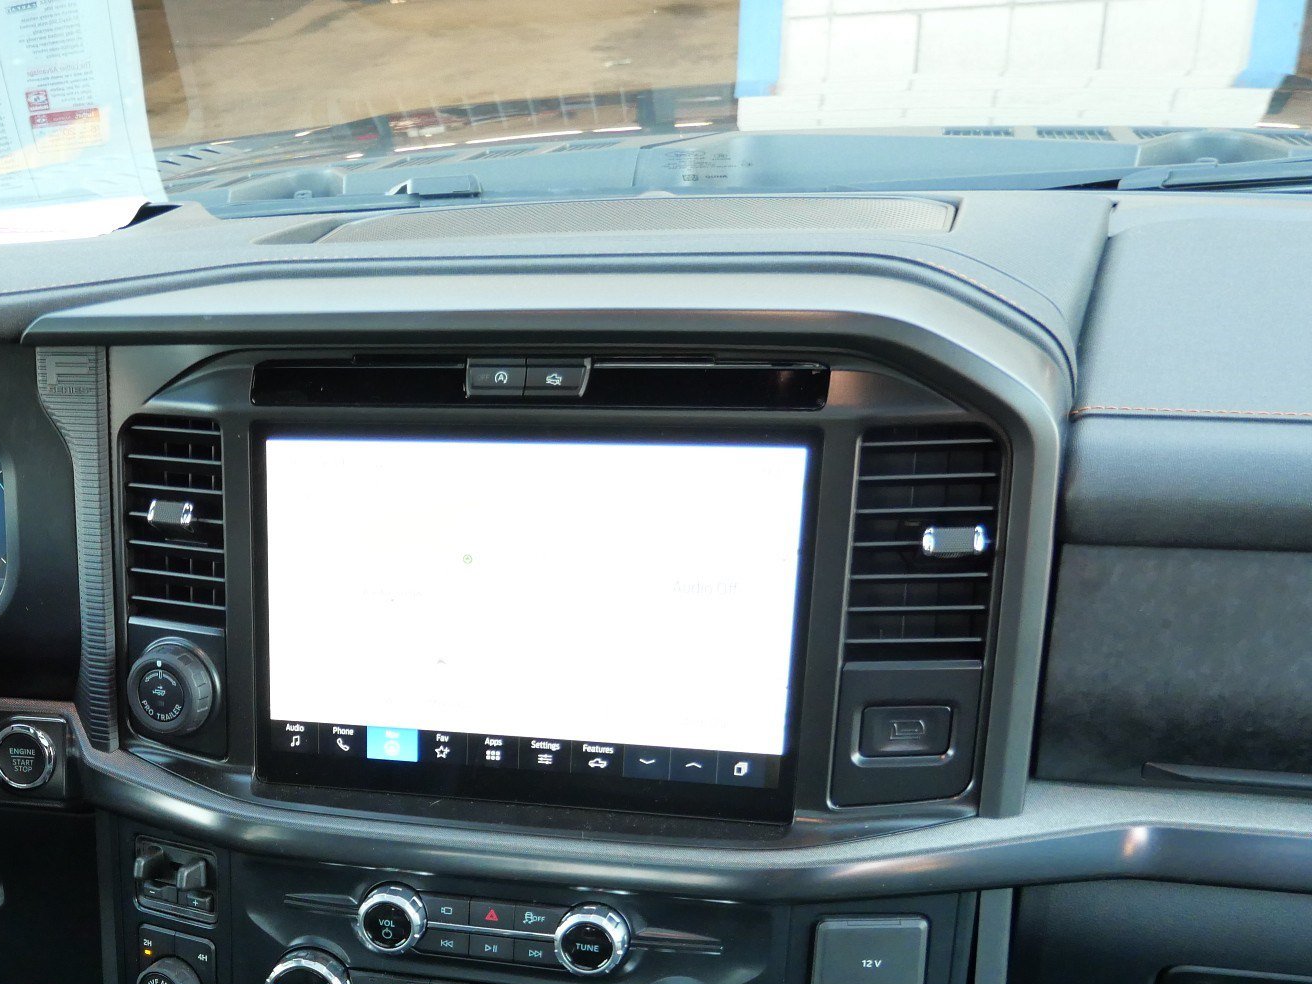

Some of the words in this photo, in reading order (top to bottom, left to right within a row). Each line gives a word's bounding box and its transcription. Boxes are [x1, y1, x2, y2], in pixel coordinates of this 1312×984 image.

[141, 700, 154, 716] PRO
[156, 704, 182, 721] TRAILER
[285, 723, 305, 733] Audio
[332, 726, 354, 736] Phone
[435, 733, 449, 742] Fav
[484, 737, 502, 748] Apps
[530, 740, 560, 751] Settings
[8, 747, 35, 756] ENGINE
[582, 744, 613, 754] Features
[12, 758, 34, 766] START
[14, 765, 33, 773] STOP
[378, 918, 395, 928] VOL
[533, 915, 545, 923] OFF
[143, 938, 152, 947] 2H
[575, 942, 600, 954] TUNE
[197, 953, 208, 962] 4H
[861, 959, 873, 968] 12
[874, 959, 882, 968] V
